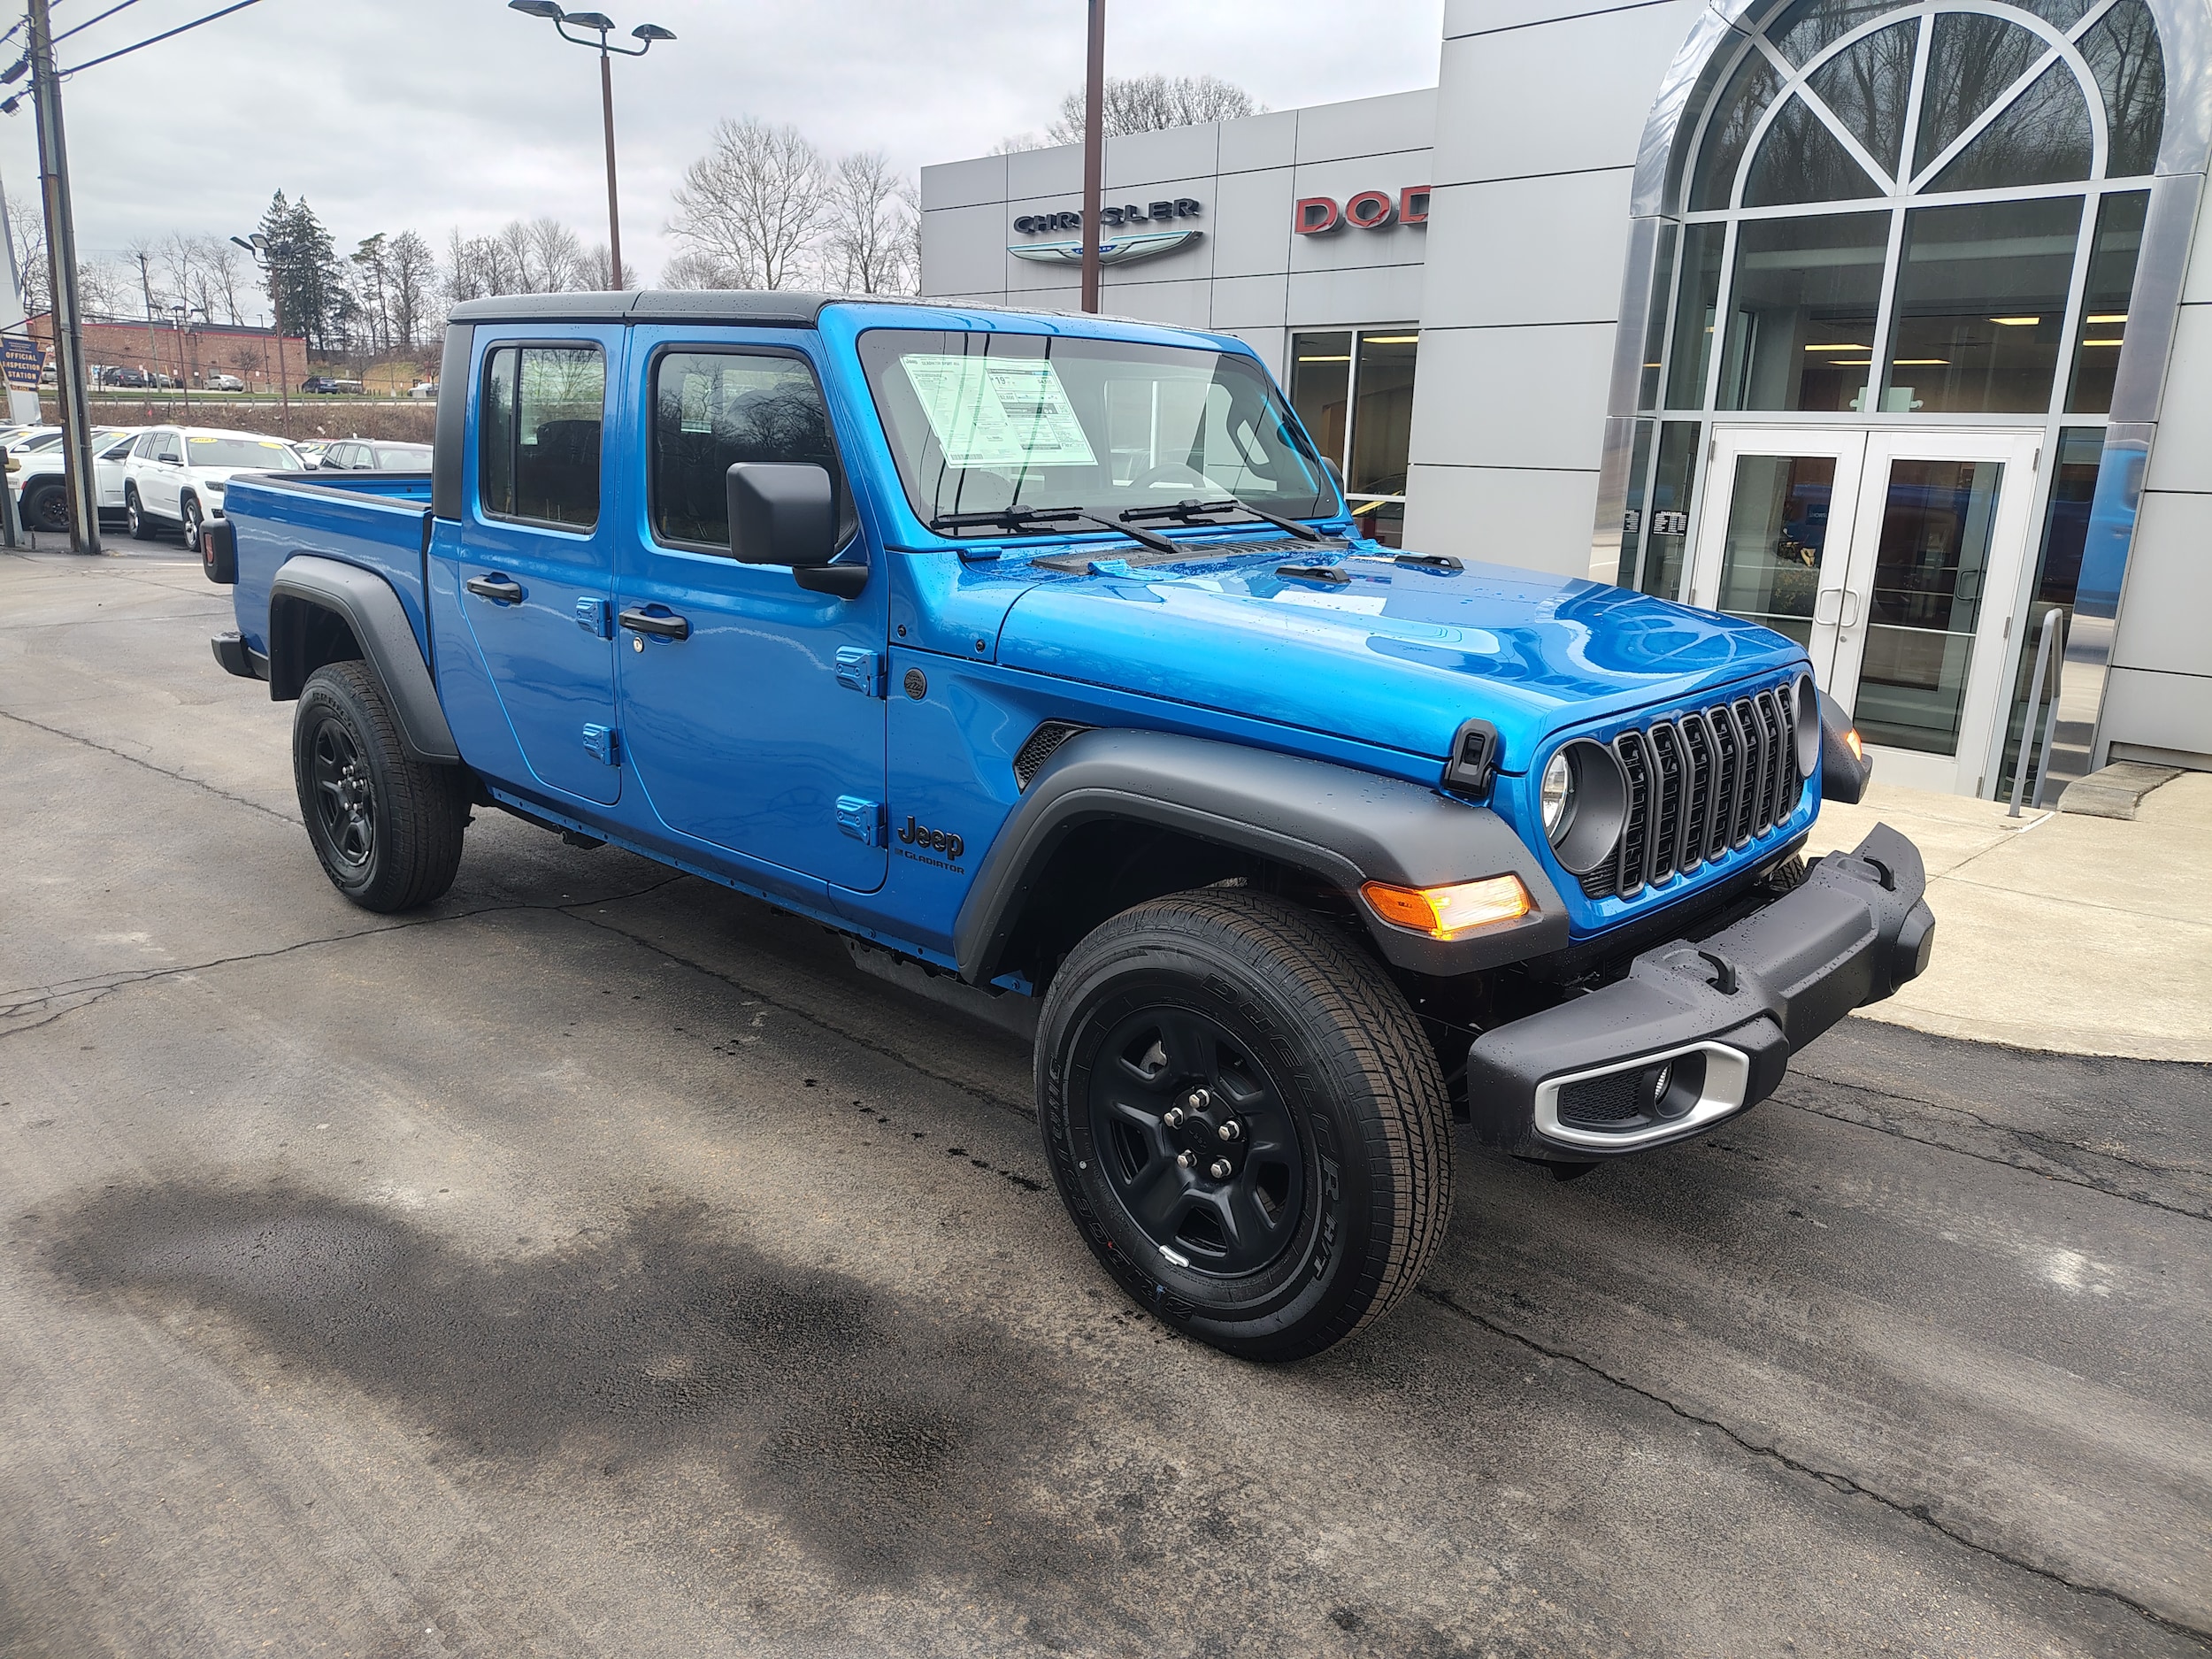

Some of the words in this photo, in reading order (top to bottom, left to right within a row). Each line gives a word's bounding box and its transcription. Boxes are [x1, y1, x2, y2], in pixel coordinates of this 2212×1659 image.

[1013, 198, 1202, 234] CHRSLER
[5, 351, 37, 362] OFFICIAL
[2, 361, 41, 372] INSPECTION
[8, 371, 37, 380] STATION
[995, 376, 1006, 385] 19
[897, 815, 964, 861] Jeep
[904, 850, 965, 875] GLADIATOR
